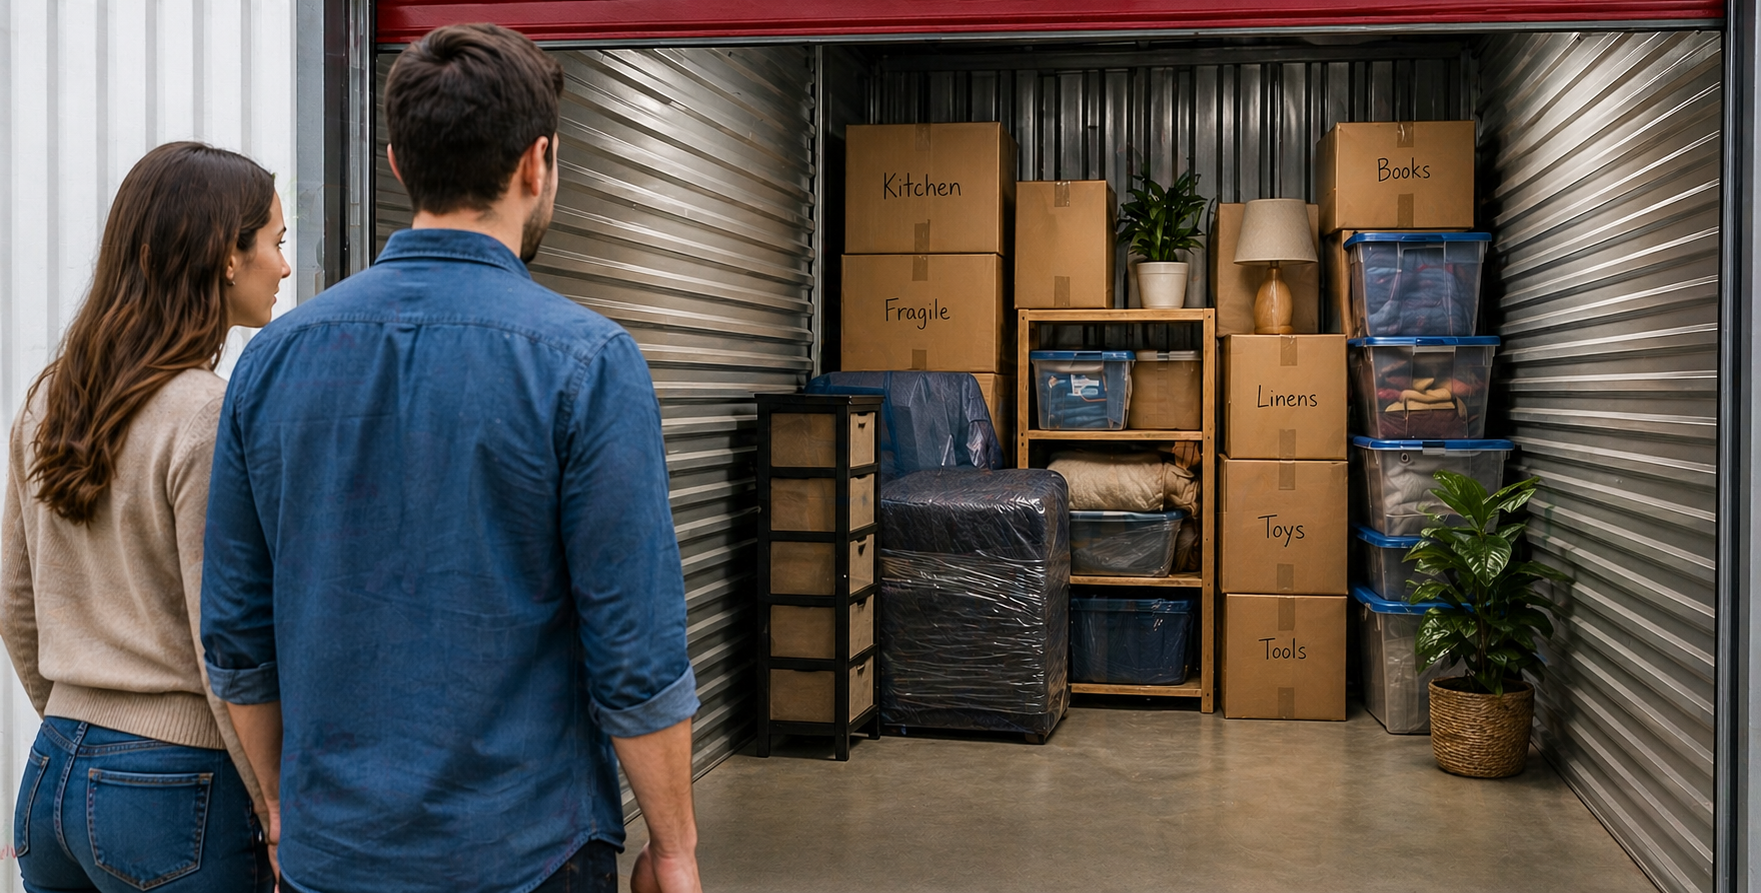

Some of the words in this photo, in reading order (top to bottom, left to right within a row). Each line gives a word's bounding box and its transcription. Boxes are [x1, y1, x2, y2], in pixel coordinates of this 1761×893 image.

[1377, 156, 1431, 182] Books
[883, 172, 962, 200] Kitchen
[885, 298, 951, 331] Fragile
[1257, 384, 1318, 409] Linens
[1258, 514, 1305, 548] Toys
[1258, 638, 1307, 661] Tools
